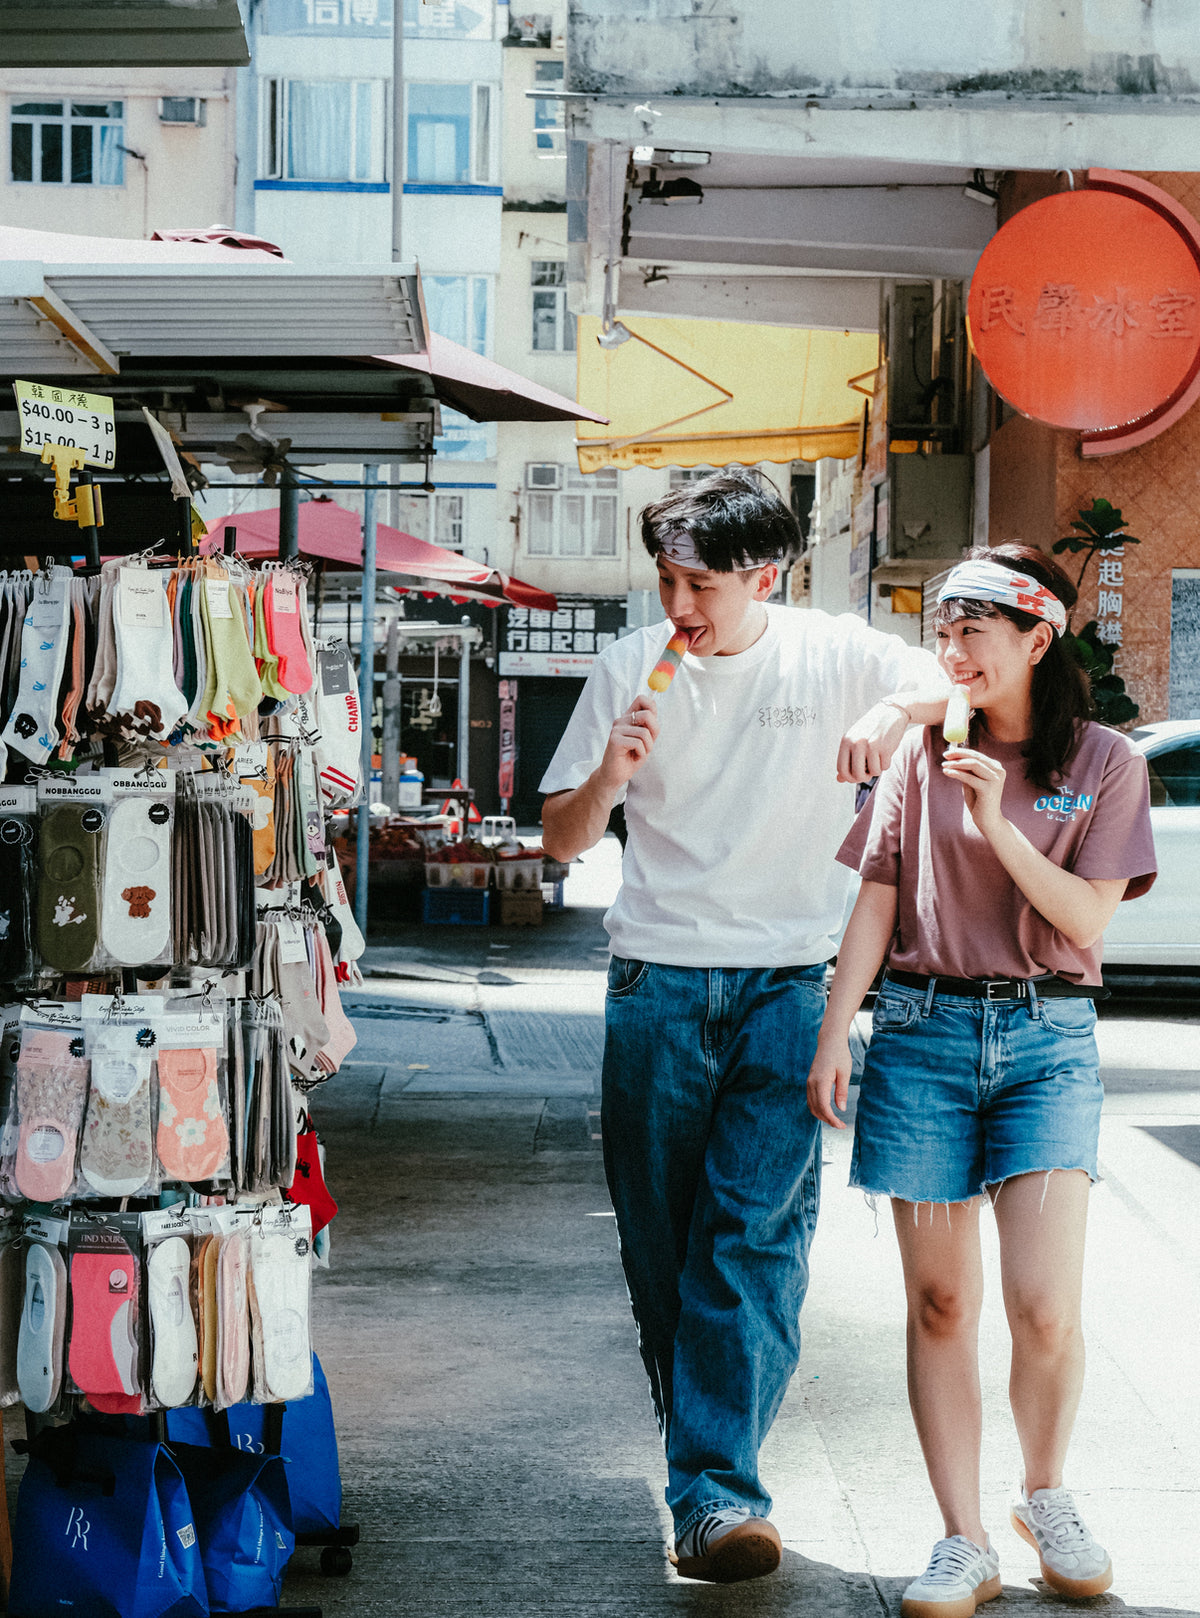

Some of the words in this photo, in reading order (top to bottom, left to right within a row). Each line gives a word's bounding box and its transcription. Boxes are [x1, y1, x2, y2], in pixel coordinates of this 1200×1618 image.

[979, 281, 1196, 338] 民聲冰室
[22, 400, 74, 424] $40.00
[25, 427, 75, 448] $1500
[345, 694, 359, 733] CHAMP
[45, 787, 101, 796] NOBBANGGGU
[81, 1234, 99, 1243] FIND
